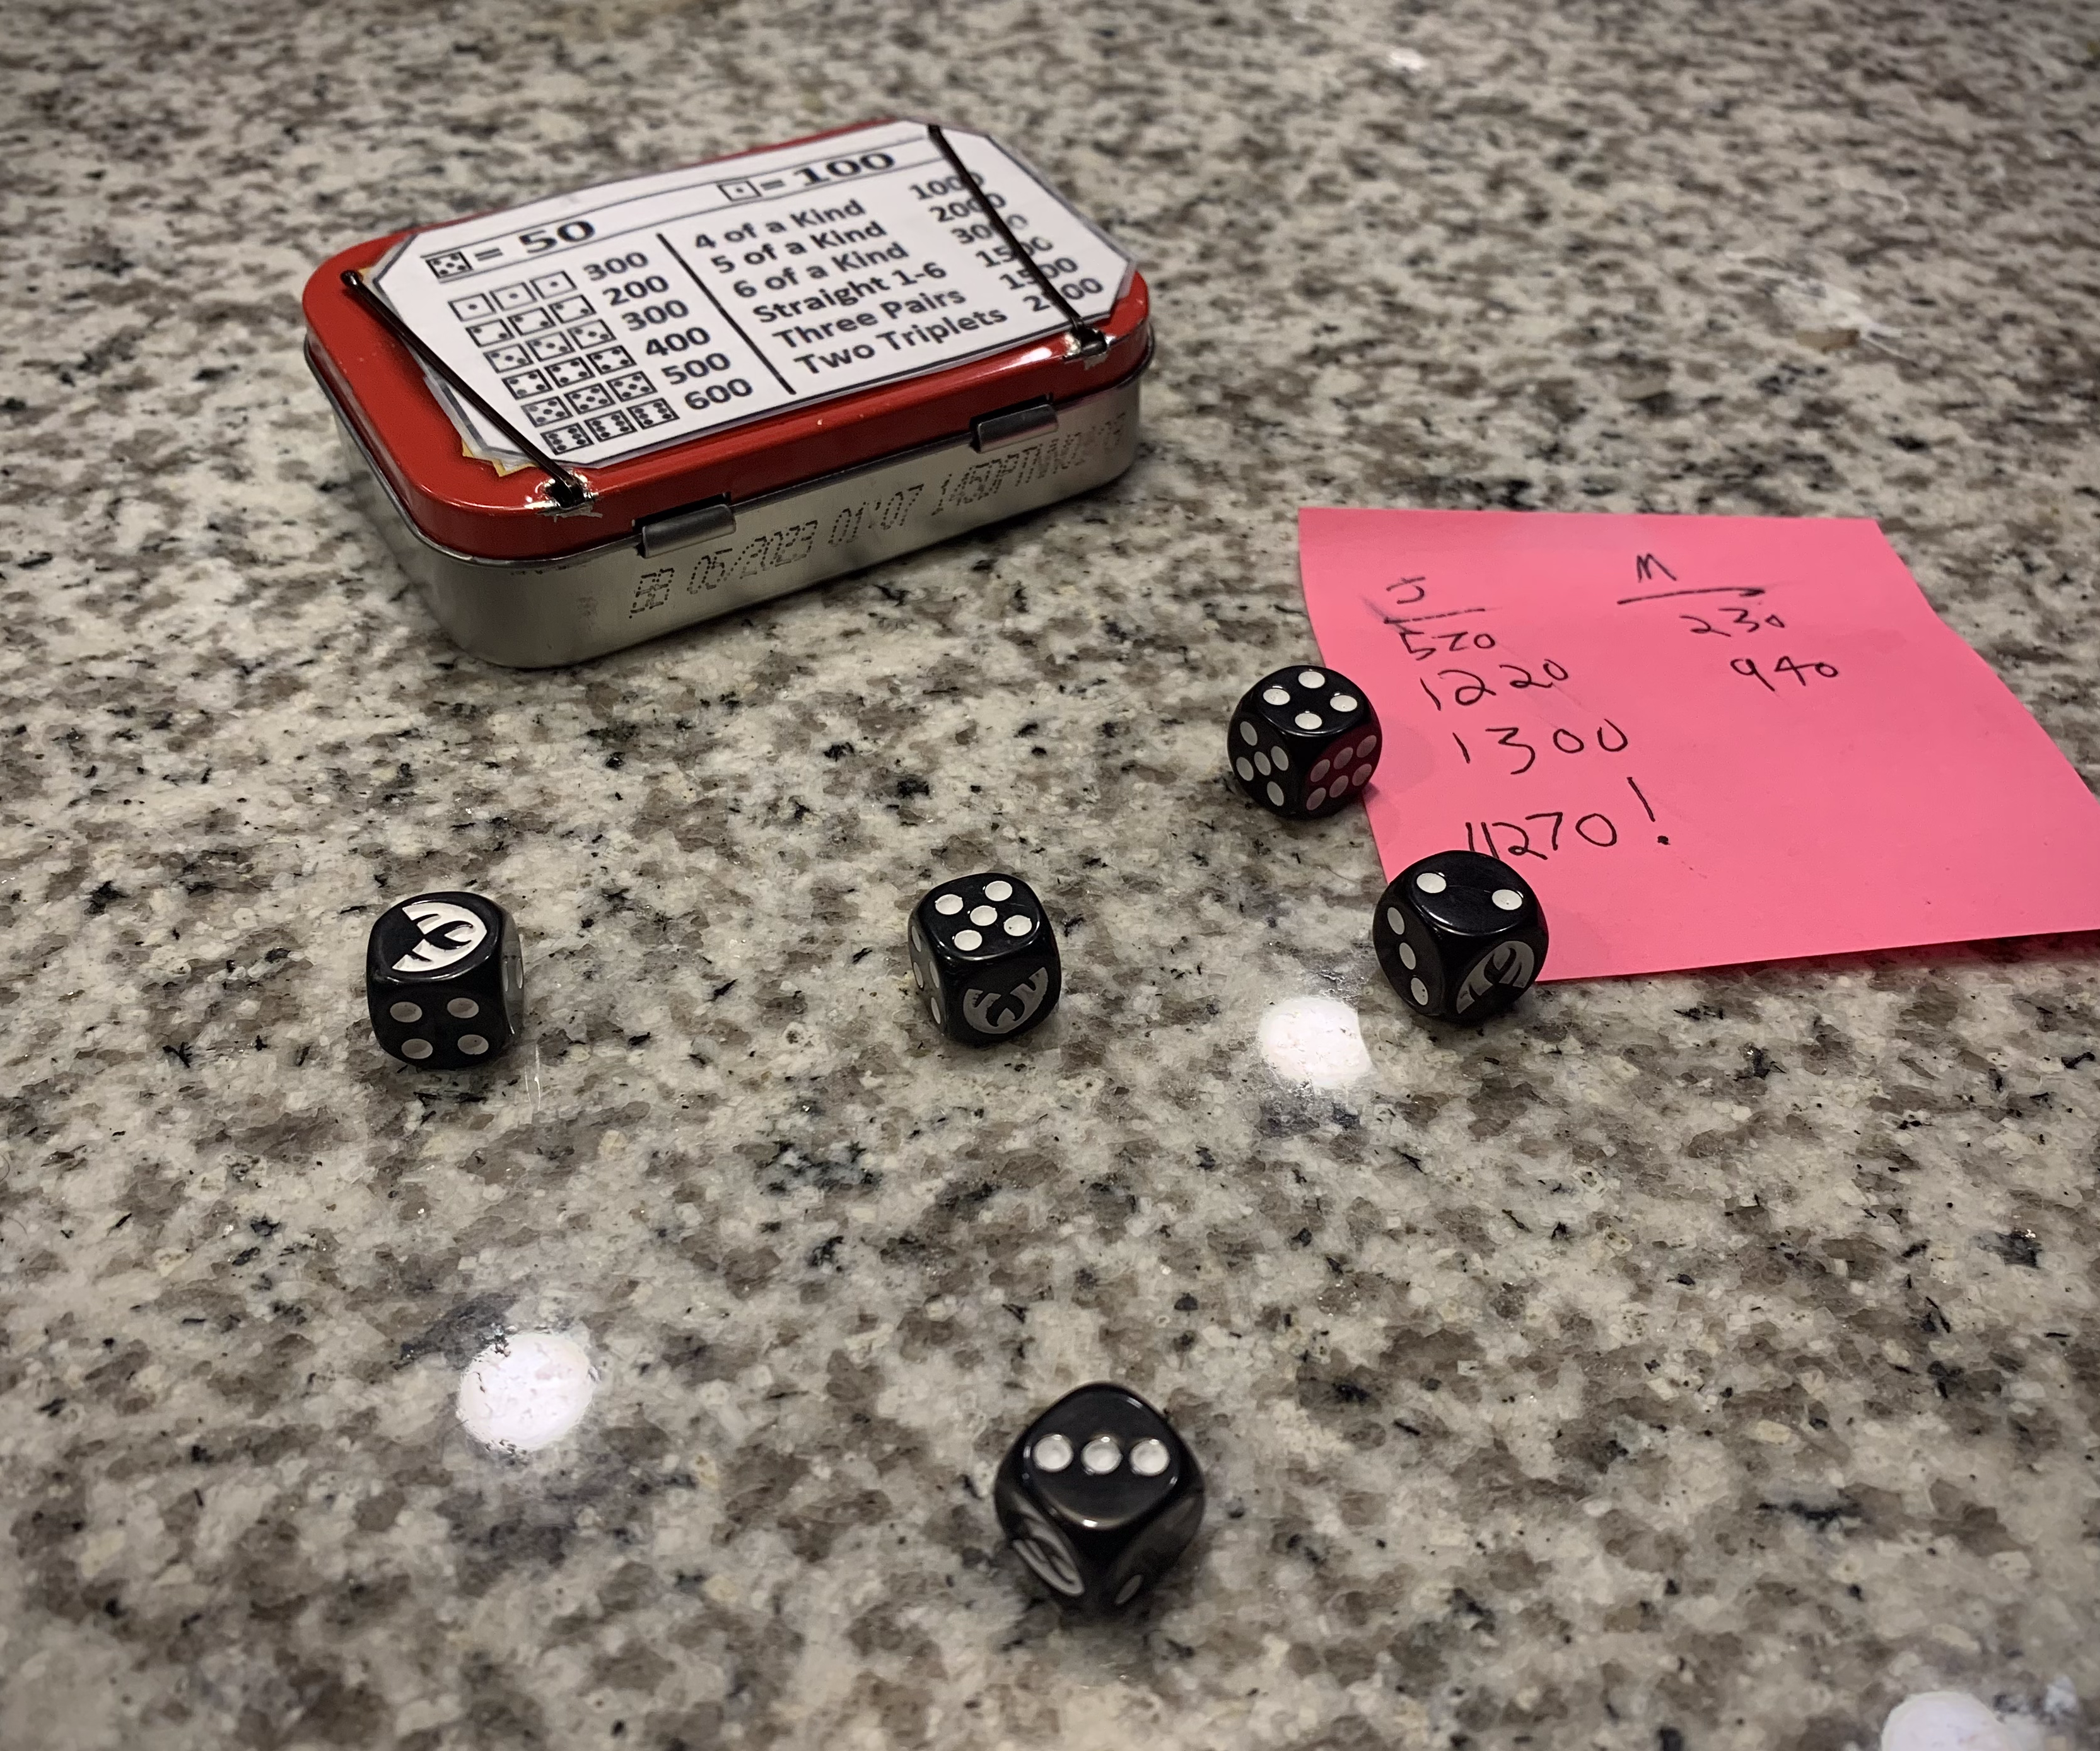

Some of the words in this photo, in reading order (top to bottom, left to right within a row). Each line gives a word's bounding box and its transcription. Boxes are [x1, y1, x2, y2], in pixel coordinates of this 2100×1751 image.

[518, 220, 595, 253] 50
[694, 233, 716, 250] 4
[724, 221, 758, 243] of
[765, 220, 787, 233] a
[790, 198, 867, 229] Kind
[711, 254, 735, 274] 5
[744, 242, 778, 265] of
[785, 241, 807, 255] a
[809, 220, 888, 250] Kind
[733, 279, 757, 298] 6
[764, 266, 800, 290] of
[806, 265, 829, 279] a
[831, 241, 910, 272] Kind
[950, 213, 1029, 245] 300
[583, 252, 649, 282] 300
[602, 275, 669, 307] 200
[753, 276, 892, 323] Straight
[892, 261, 947, 287] 1-6
[622, 300, 689, 331] 300
[772, 312, 878, 349] Three
[880, 288, 967, 320] Pairs
[793, 343, 876, 375] Two
[875, 308, 1009, 351] Triplets
[1022, 277, 1104, 312] 200
[645, 327, 711, 357] 400
[661, 353, 730, 385] 500
[684, 378, 753, 411] 600
[1636, 553, 1677, 583] M
[1678, 607, 1786, 638] 230
[1420, 658, 1569, 712] 1220
[1730, 655, 1839, 692] 940
[1452, 718, 1628, 775] 1300
